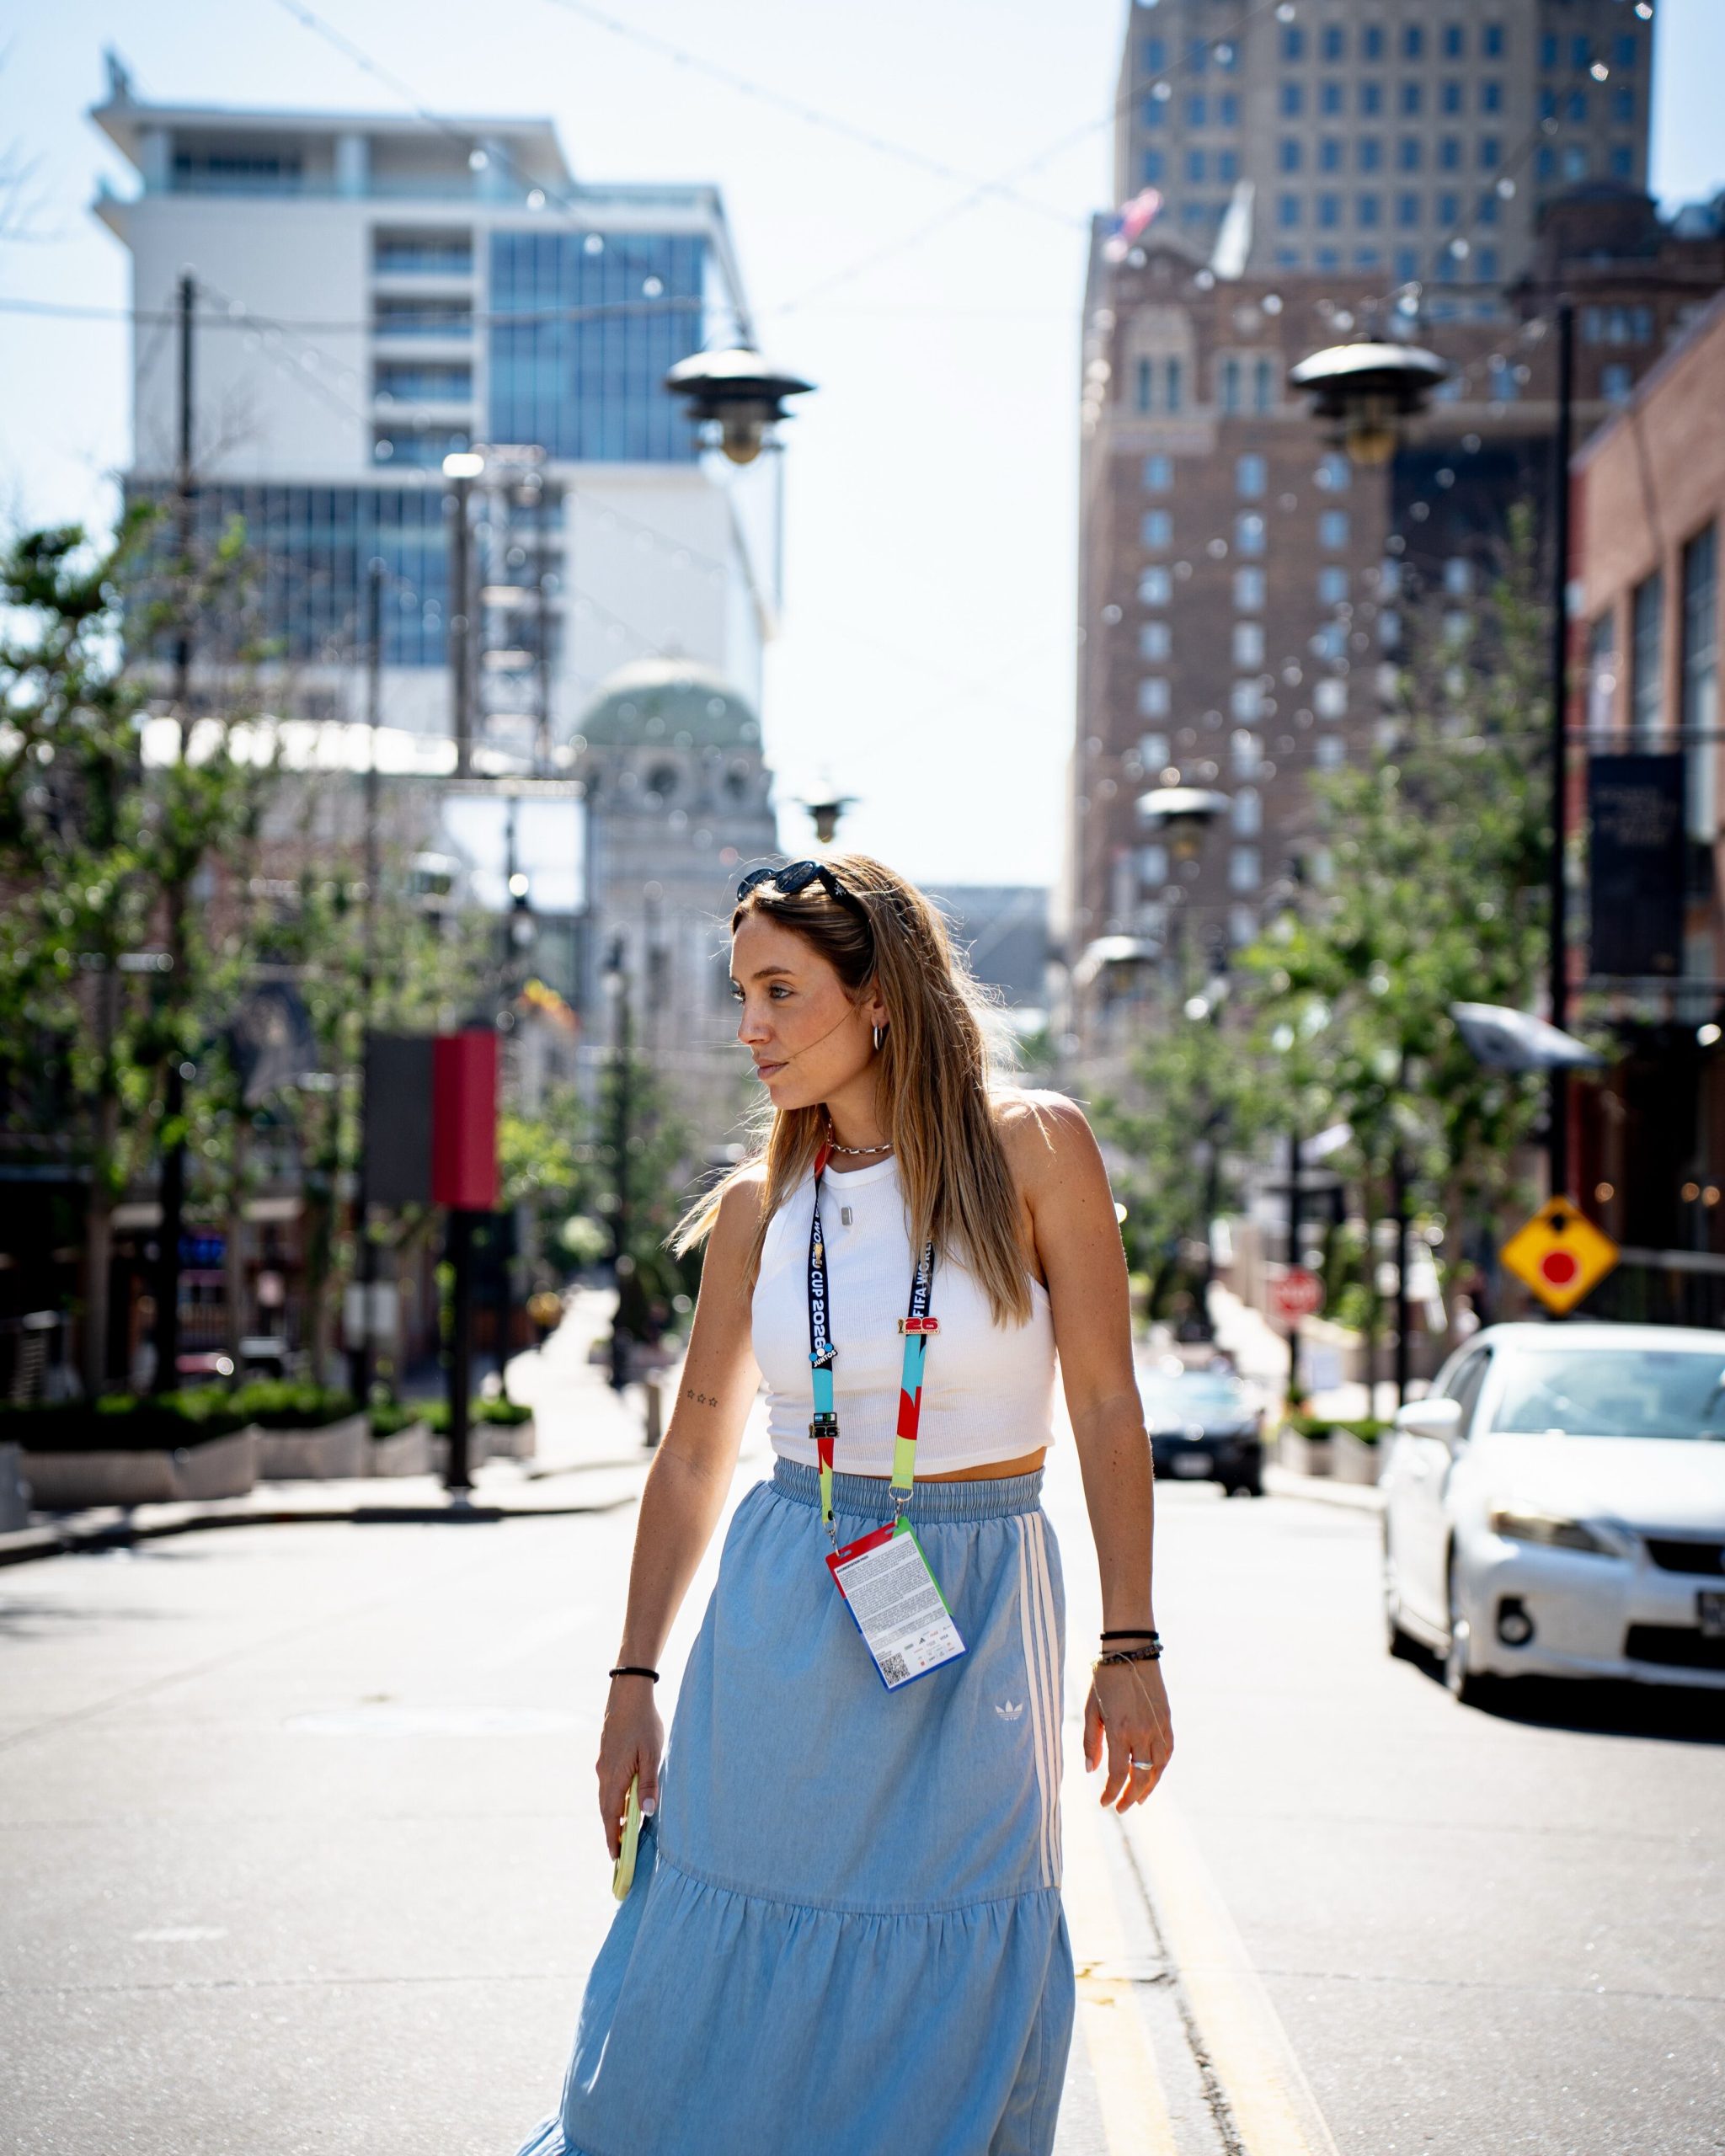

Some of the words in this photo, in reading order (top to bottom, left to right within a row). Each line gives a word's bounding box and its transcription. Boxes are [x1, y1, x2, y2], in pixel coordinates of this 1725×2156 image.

[812, 1221, 823, 1268] WOD
[916, 1239, 932, 1285] WORL
[811, 1271, 824, 1297] CUP
[912, 1287, 927, 1317] FIFA
[812, 1299, 826, 1350] 2026
[905, 1317, 937, 1330] 26
[814, 1349, 836, 1367] JUNTOS
